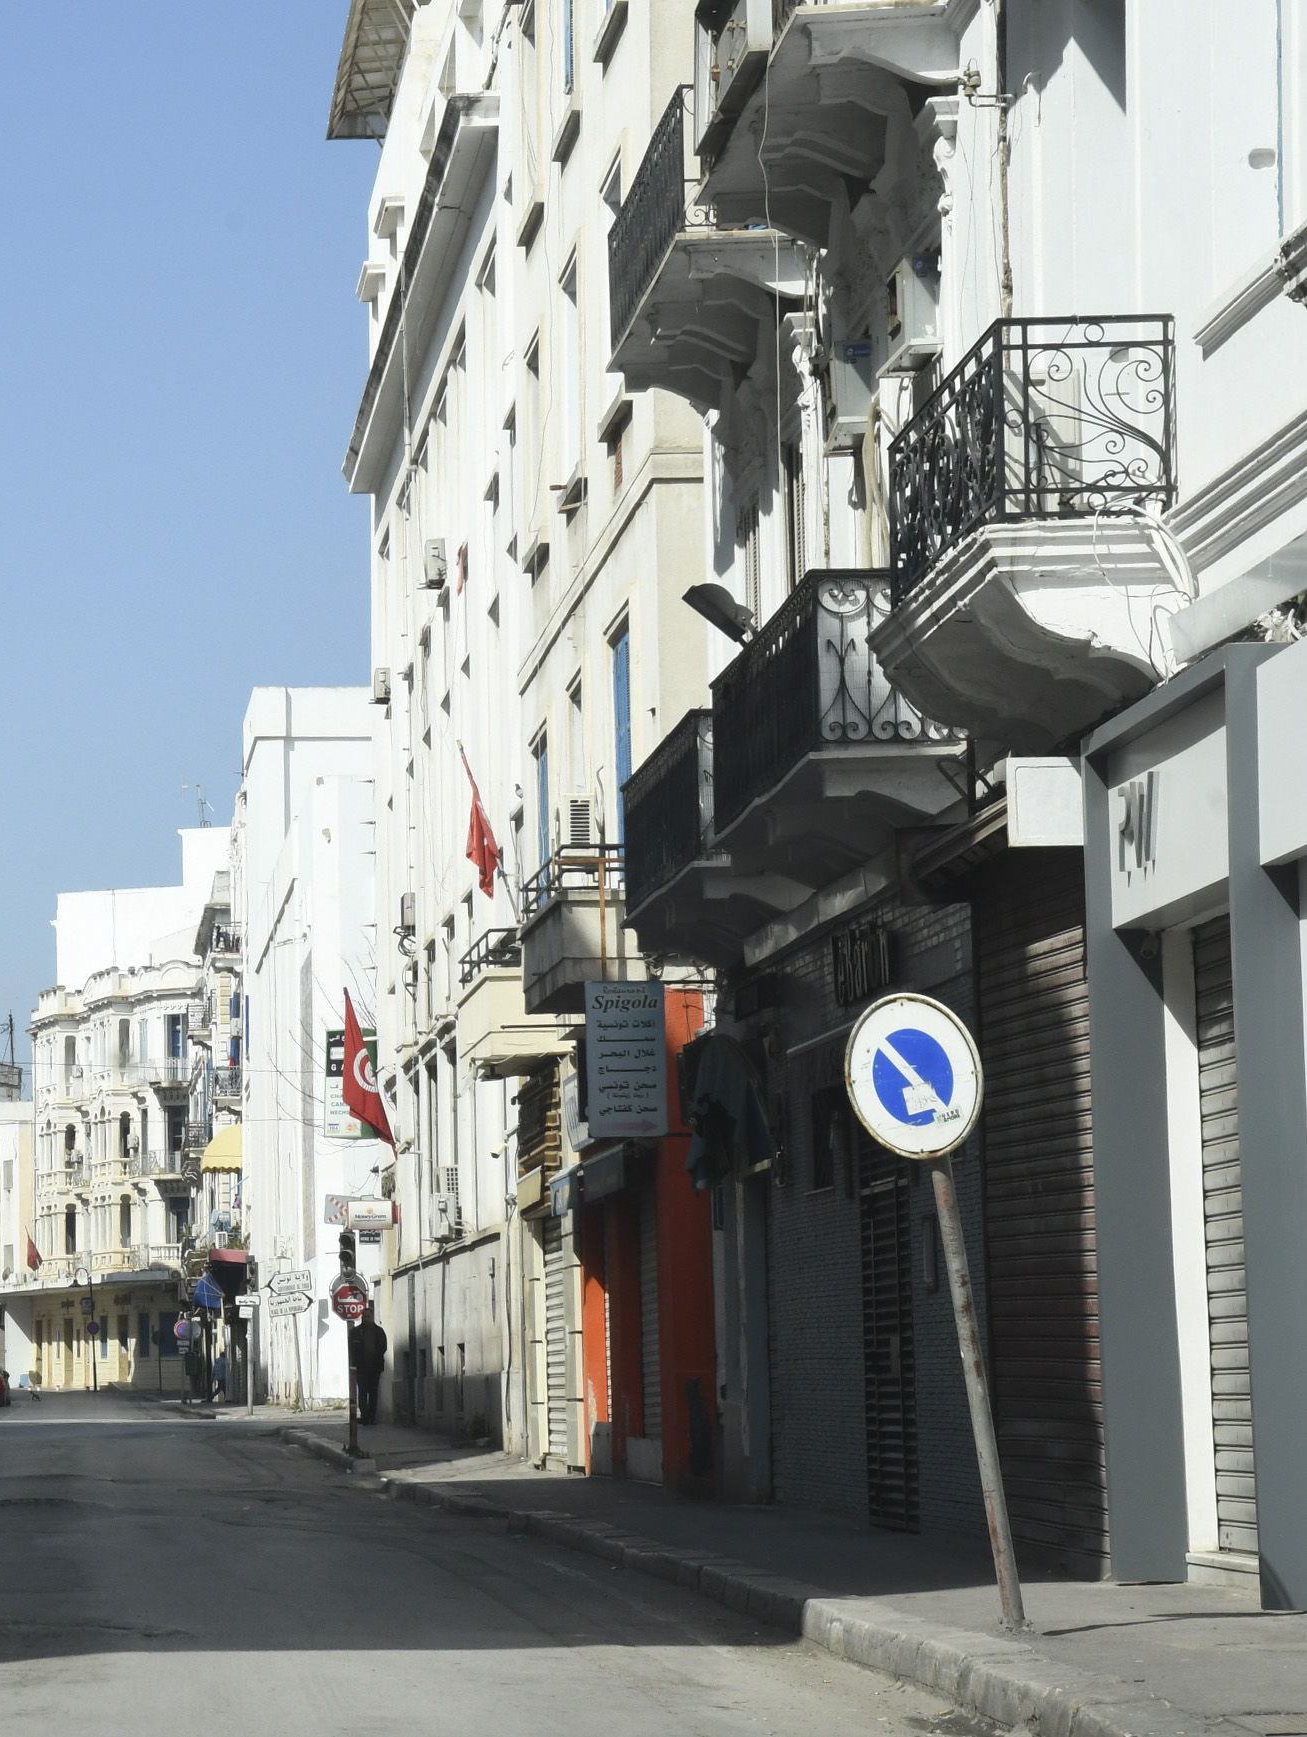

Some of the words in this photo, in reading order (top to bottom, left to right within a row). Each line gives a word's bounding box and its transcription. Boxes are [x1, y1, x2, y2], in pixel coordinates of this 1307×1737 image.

[592, 994, 659, 1013] Spigola
[596, 1019, 629, 1031] تونسية
[598, 1049, 630, 1060] البحر
[634, 1048, 656, 1059] غلال
[598, 1081, 630, 1093] تونسي
[634, 1082, 657, 1091] صحن
[636, 1104, 658, 1115] صحن
[277, 1275, 291, 1285] تونس
[337, 1304, 364, 1313] STOP
